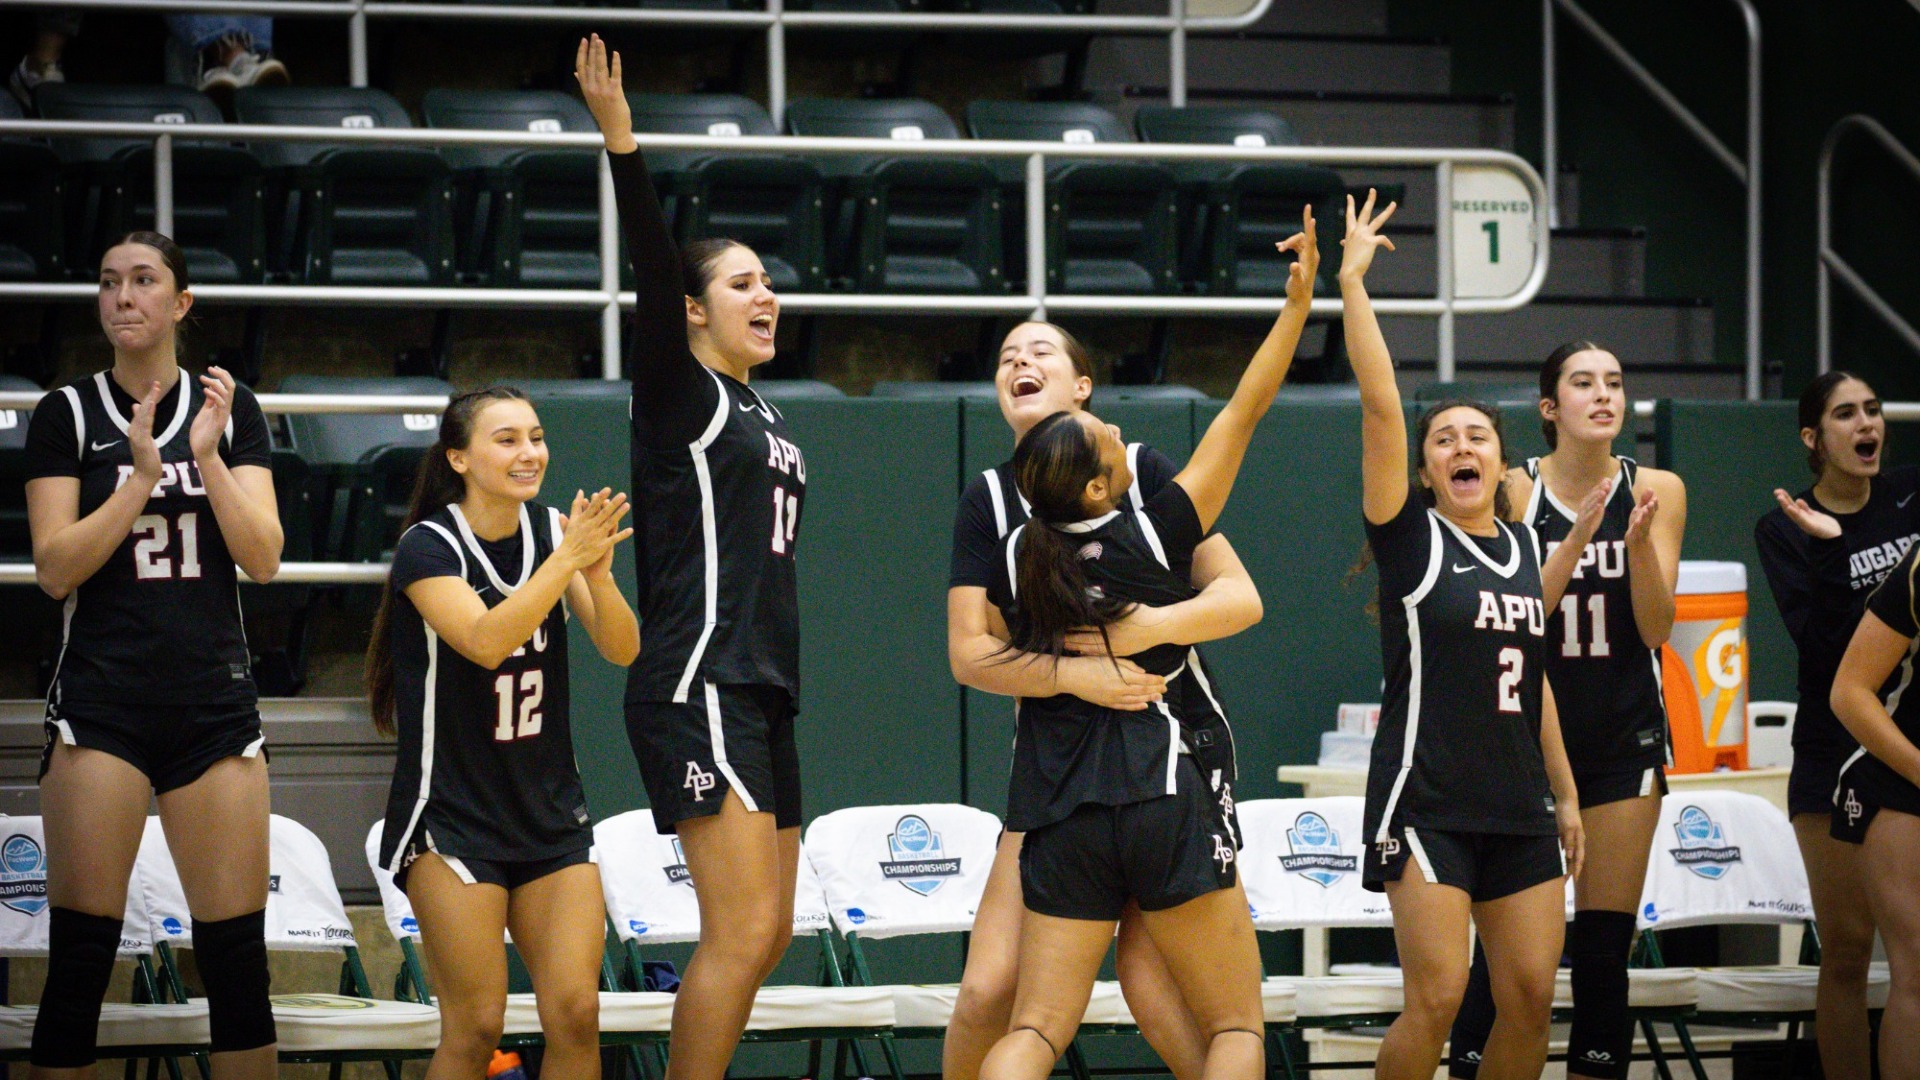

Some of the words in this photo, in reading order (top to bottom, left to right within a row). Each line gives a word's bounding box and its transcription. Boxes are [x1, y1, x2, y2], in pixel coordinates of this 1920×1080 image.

[1452, 200, 1530, 213] RESERVED
[1481, 220, 1500, 264] 1
[765, 431, 806, 486] APU
[132, 511, 203, 580] 21
[1546, 540, 1626, 579] PU
[1474, 590, 1545, 638] APU
[1558, 593, 1610, 658] 11
[1498, 646, 1525, 713] 2
[1705, 627, 1742, 690] G
[494, 668, 545, 742] 12
[1, 872, 47, 882] BASKETBAL
[883, 861, 958, 875] CHAMPIONSHIPS
[1283, 856, 1356, 869] CHAMPIONSHIPS
[0, 883, 46, 895] AMPIONS
[287, 929, 310, 937] MAKE
